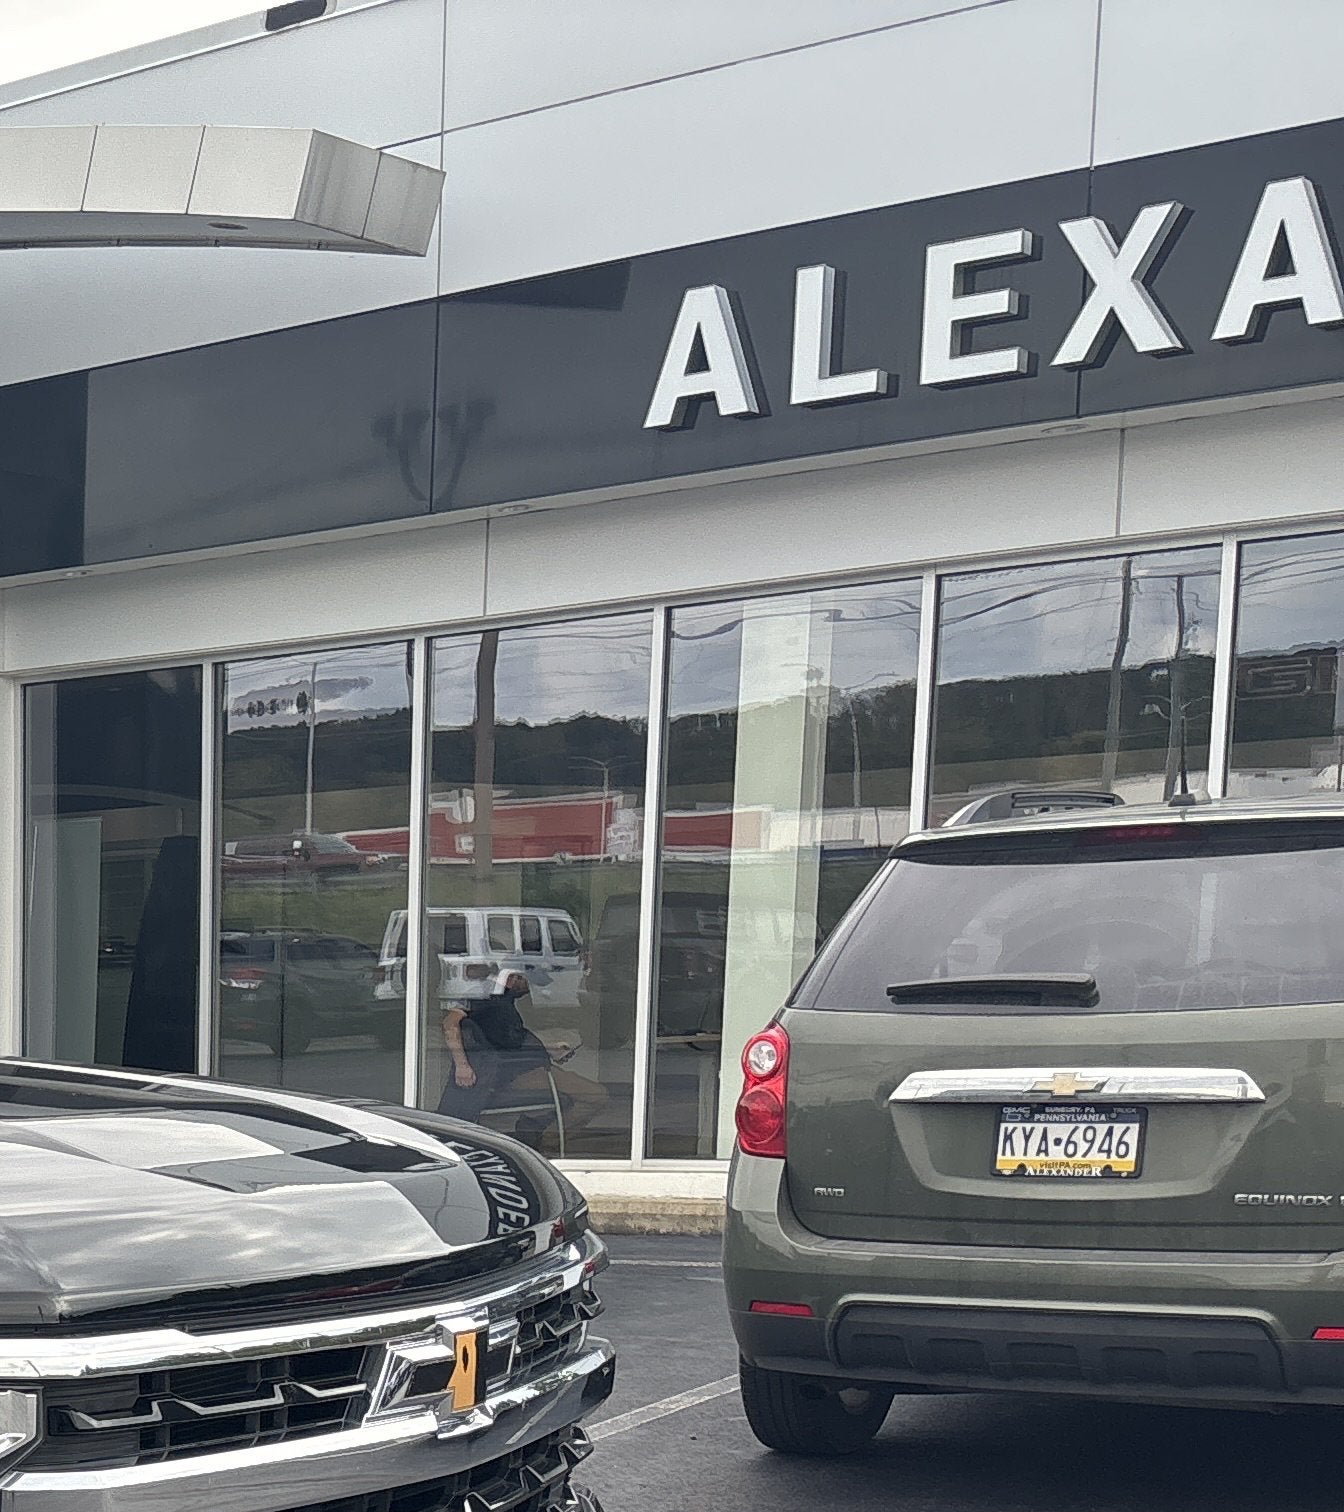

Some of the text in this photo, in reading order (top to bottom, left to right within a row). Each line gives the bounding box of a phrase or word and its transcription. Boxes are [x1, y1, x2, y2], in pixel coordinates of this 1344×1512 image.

[642, 175, 1344, 429] ALEXA
[1033, 1113, 1108, 1122] PENNSYLVANIA
[1234, 1194, 1333, 1206] EQUINOX
